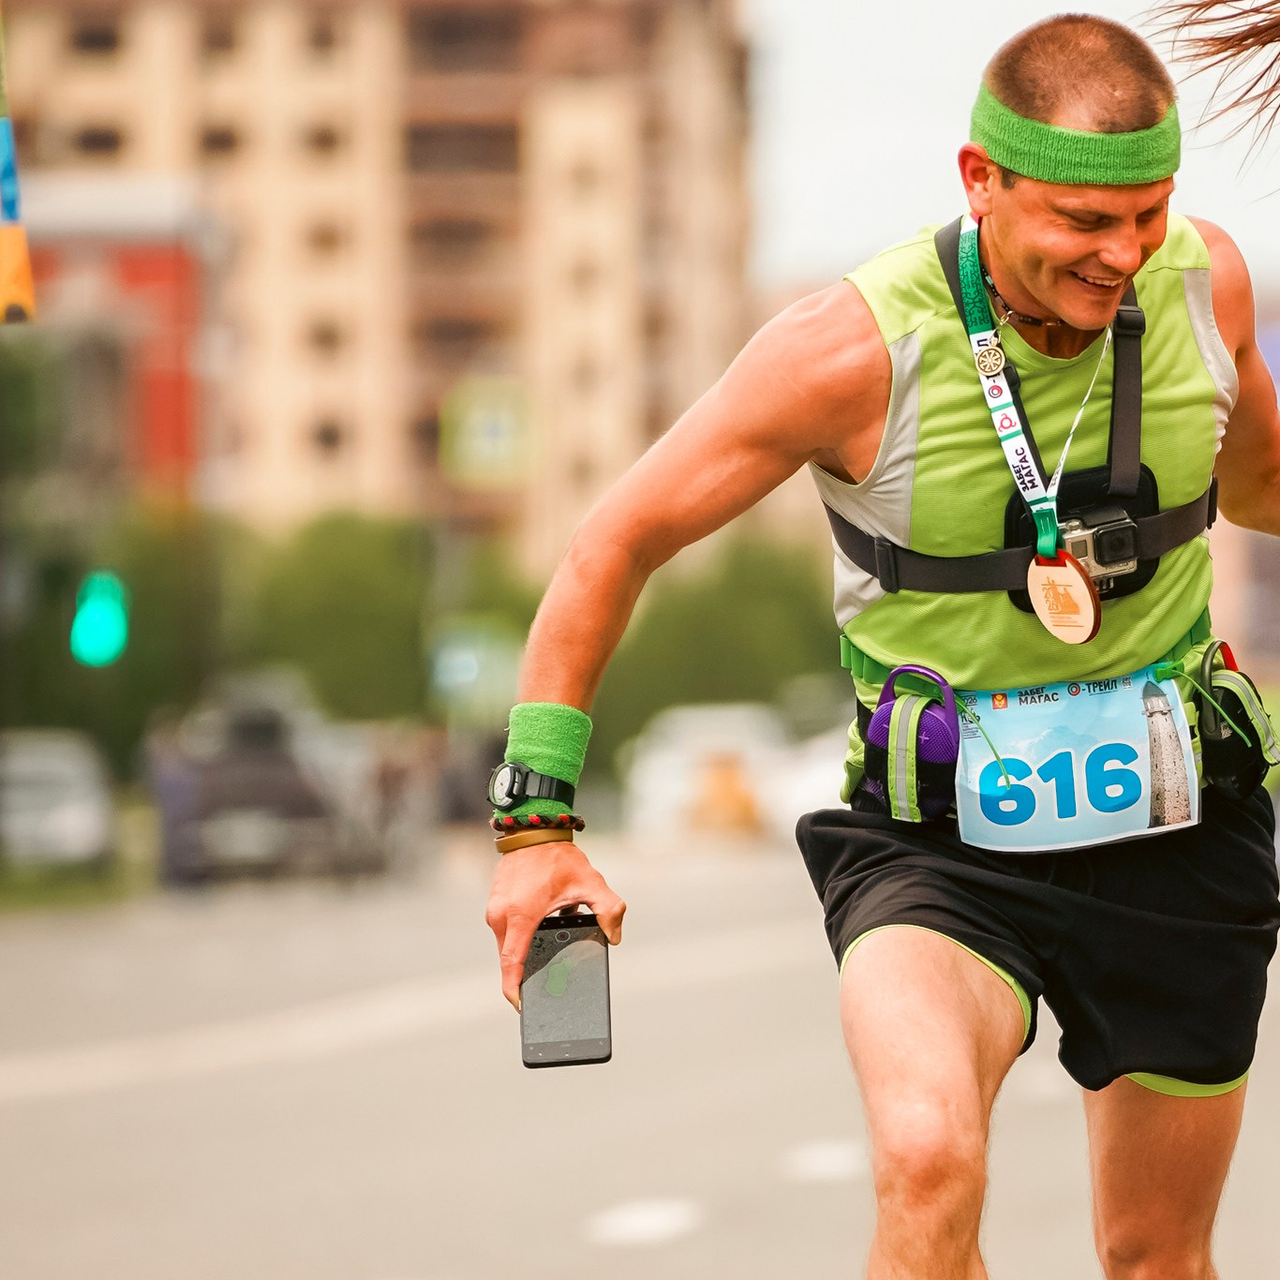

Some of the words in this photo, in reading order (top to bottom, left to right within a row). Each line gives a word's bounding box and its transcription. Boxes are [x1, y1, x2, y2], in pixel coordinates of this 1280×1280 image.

[1011, 464, 1030, 492] ЗАБЕГ
[1015, 447, 1039, 490] МАГАС
[1017, 686, 1046, 697] ЗАБЕГ
[1018, 692, 1060, 706] МАГАС
[979, 743, 1142, 826] 616
